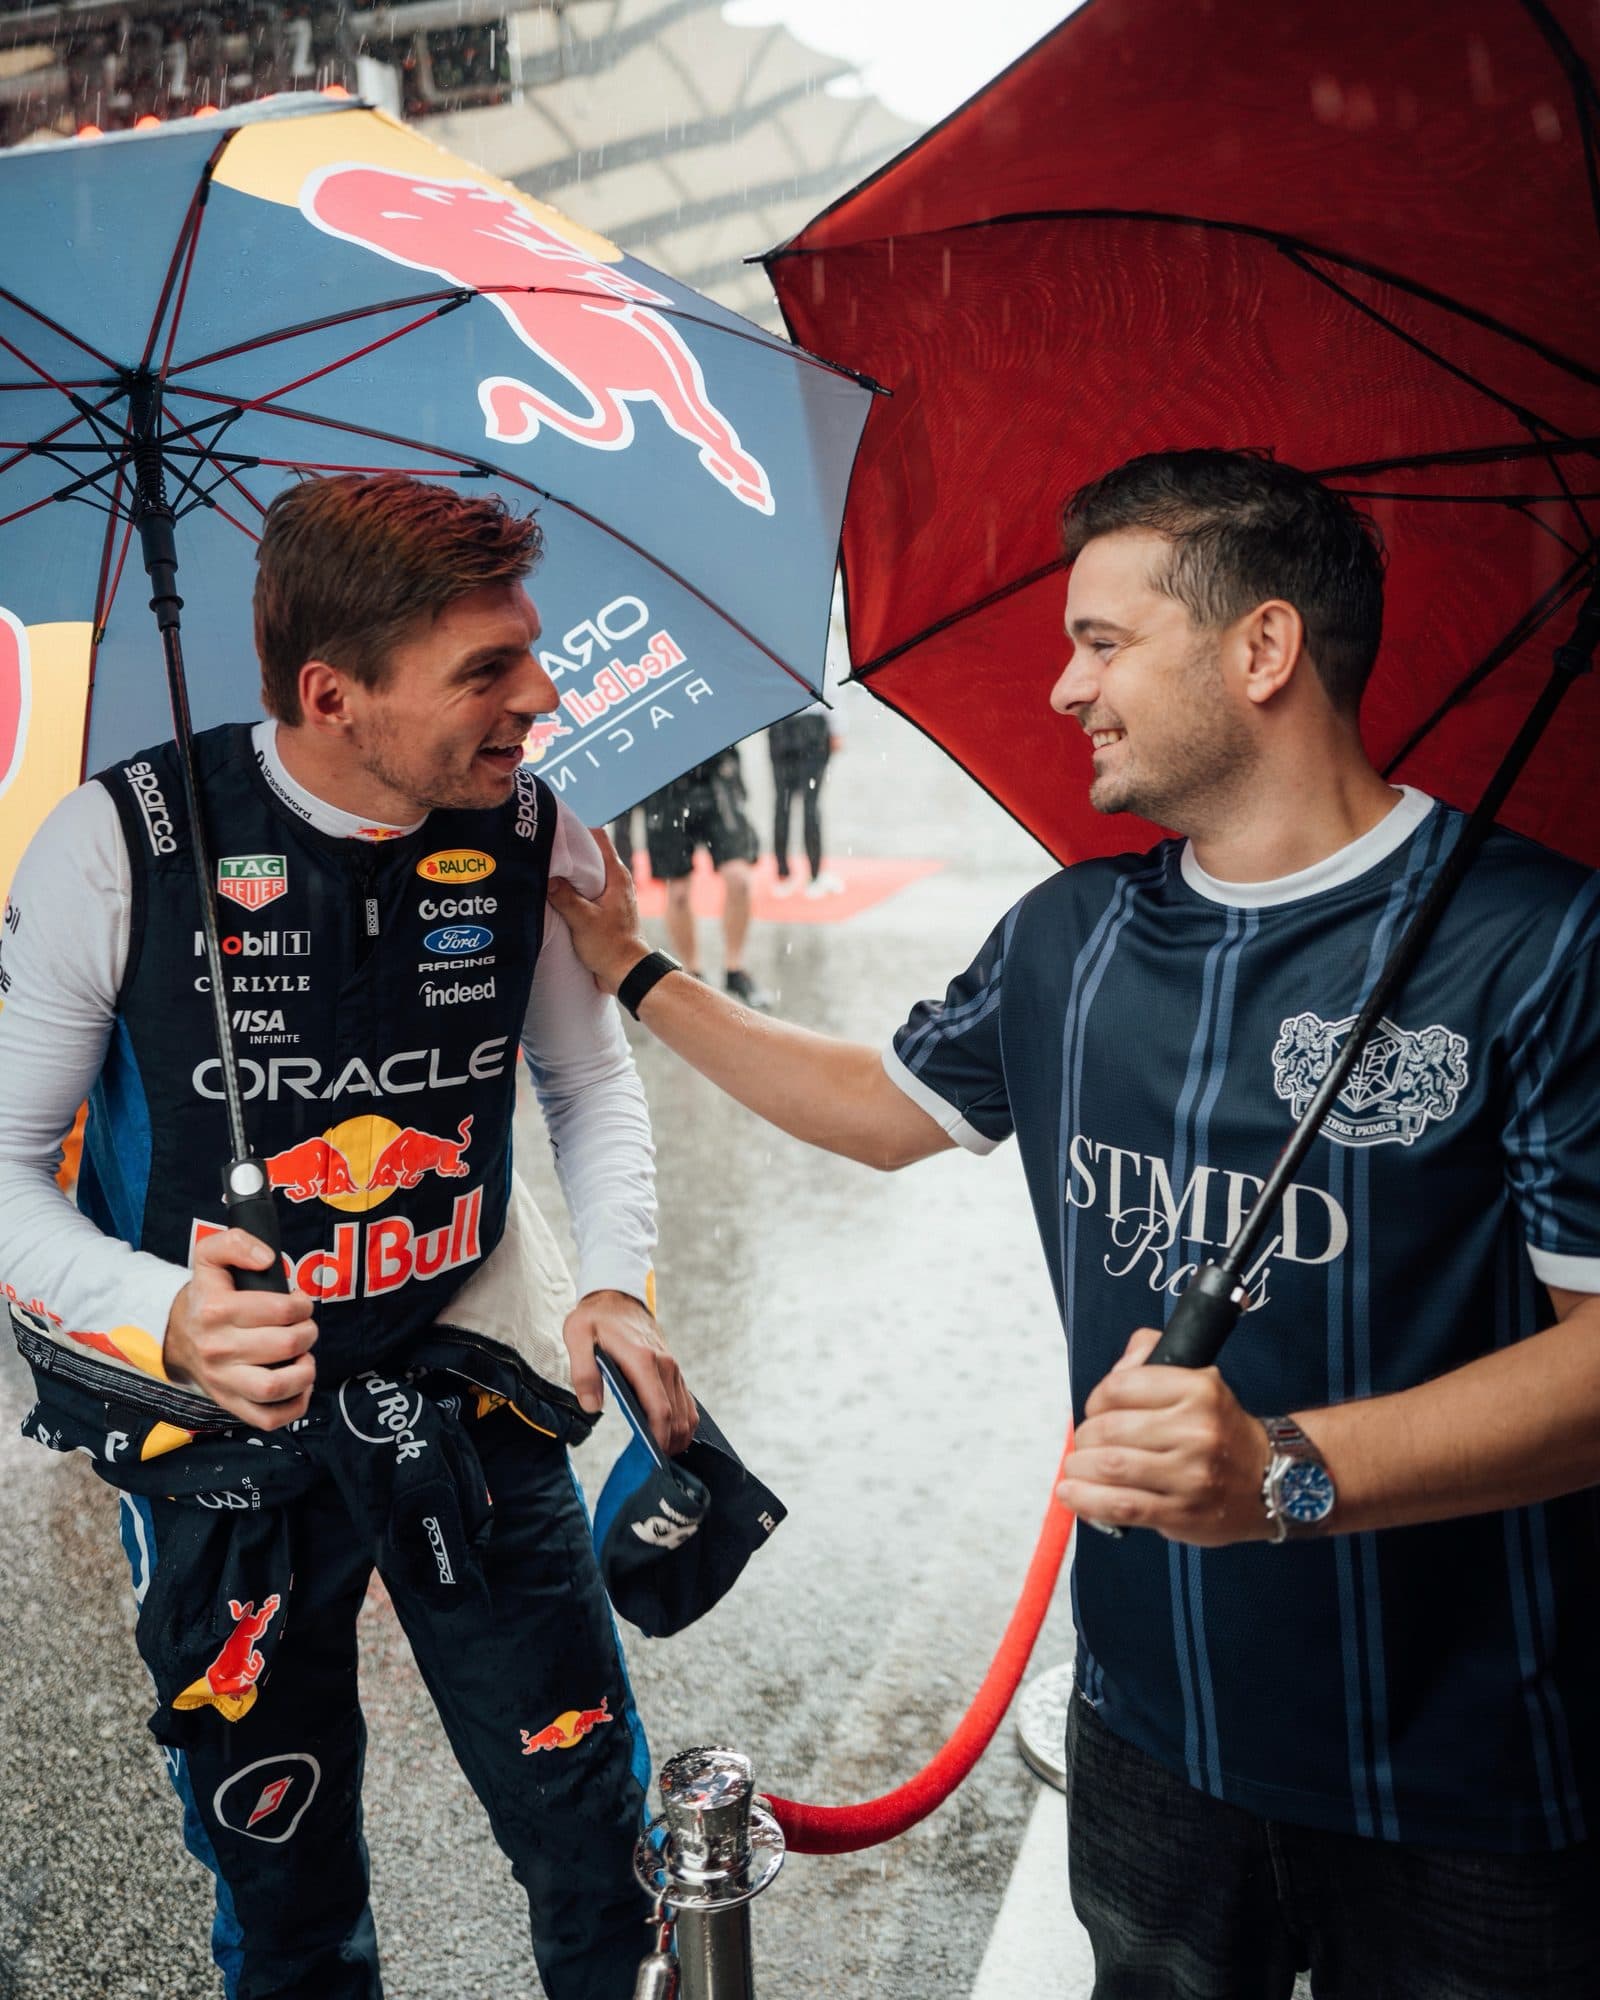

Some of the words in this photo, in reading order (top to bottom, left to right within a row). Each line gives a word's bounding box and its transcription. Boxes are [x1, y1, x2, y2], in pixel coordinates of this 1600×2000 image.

[123, 761, 177, 856] sparco
[515, 768, 539, 842] sparc
[224, 860, 281, 876] TAG
[439, 857, 486, 874] RAUCH
[222, 880, 283, 905] HEUER
[438, 930, 479, 949] Ford
[418, 956, 496, 973] RACING
[194, 976, 310, 992] CRLYLE
[420, 976, 496, 1007] indeed
[249, 1034, 300, 1044] INFINITE
[192, 1036, 508, 1101] ORACLE
[364, 1184, 483, 1298] Bull
[376, 1391, 428, 1465] Rock
[423, 1516, 456, 1585] parco
